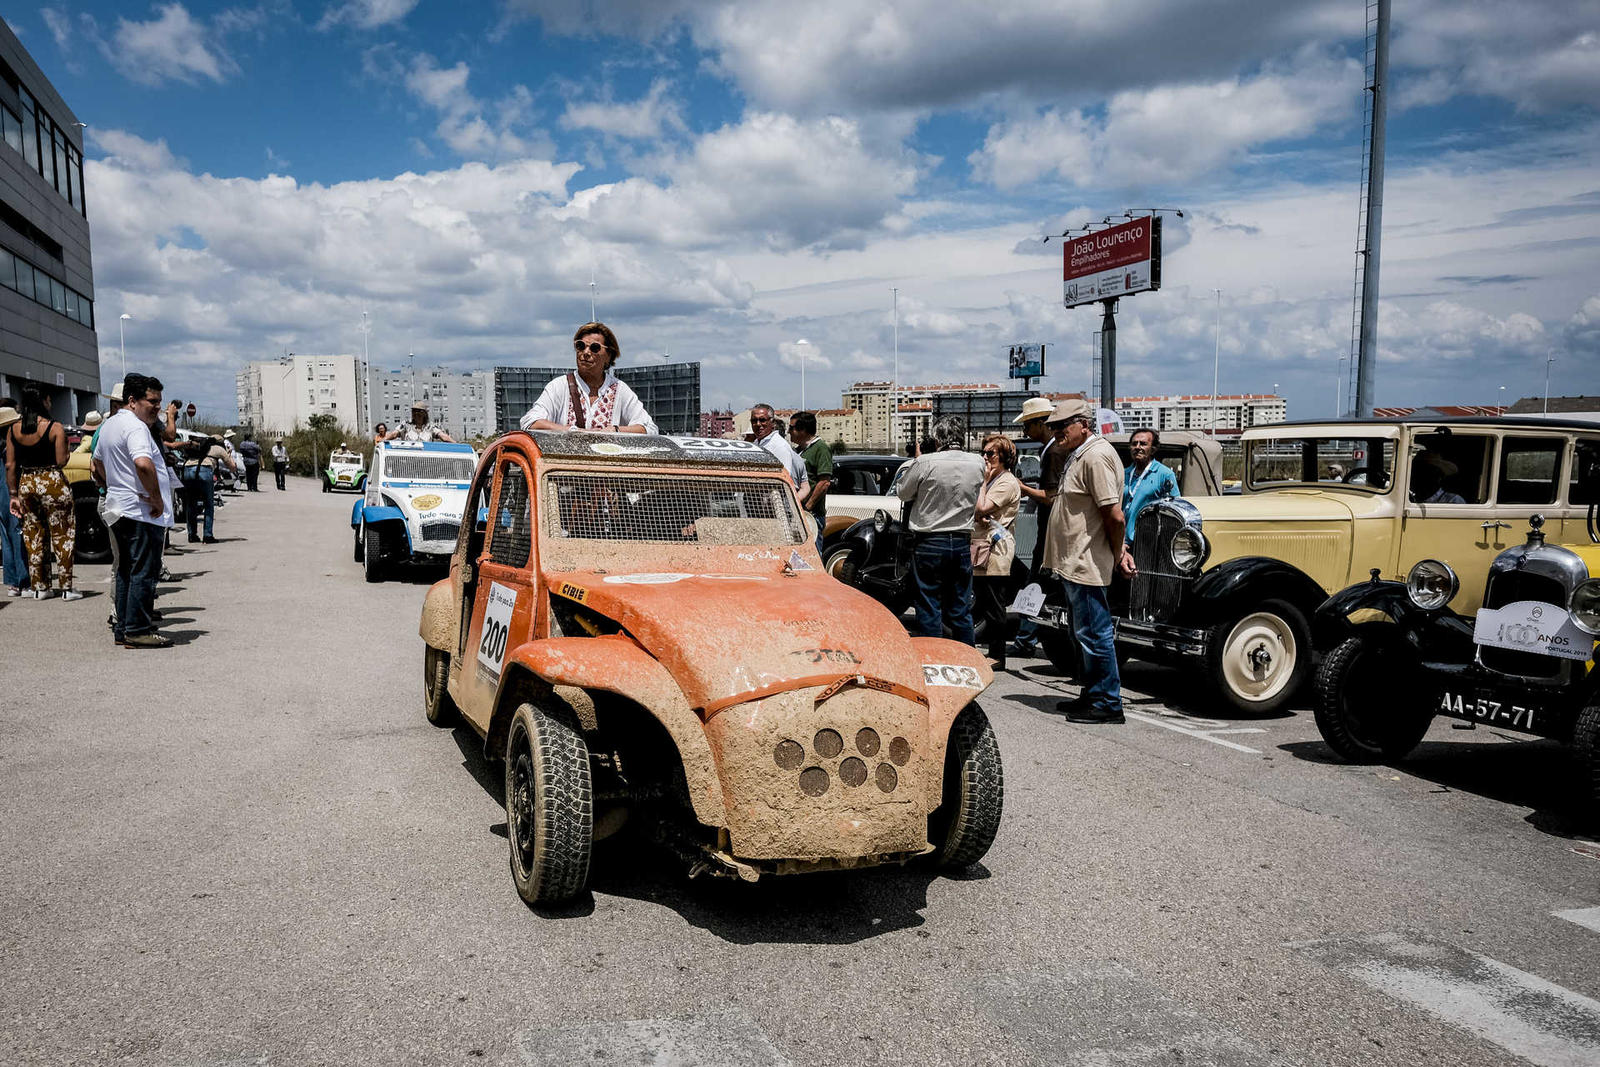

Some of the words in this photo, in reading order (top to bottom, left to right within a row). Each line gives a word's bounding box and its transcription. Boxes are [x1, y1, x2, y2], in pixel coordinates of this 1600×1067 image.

[1071, 241, 1094, 257] João
[1096, 227, 1143, 249] Lourenço
[1071, 250, 1110, 267] Empilhadores
[682, 439, 753, 449] 200
[480, 616, 508, 664] 200
[1537, 634, 1569, 646] ANOS
[1545, 645, 1573, 655] PORTUGAL
[1441, 692, 1534, 729] AA-57-71
